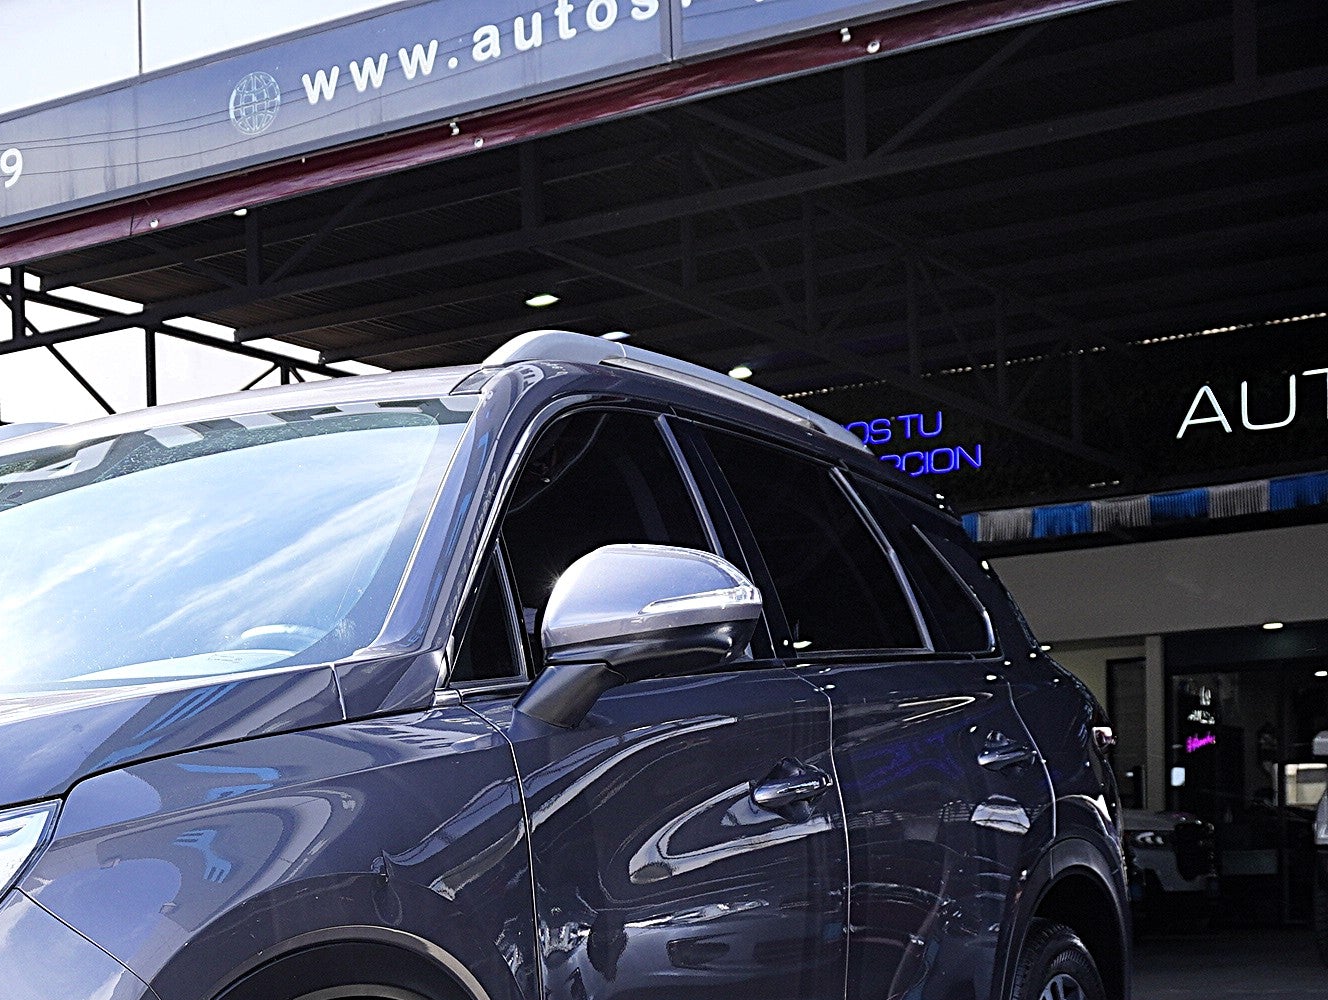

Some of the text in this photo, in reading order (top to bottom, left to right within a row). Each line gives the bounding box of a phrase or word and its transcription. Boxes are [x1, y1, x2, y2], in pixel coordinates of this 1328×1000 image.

[301, 0, 764, 105] www.autos
[843, 410, 943, 445] OS TU
